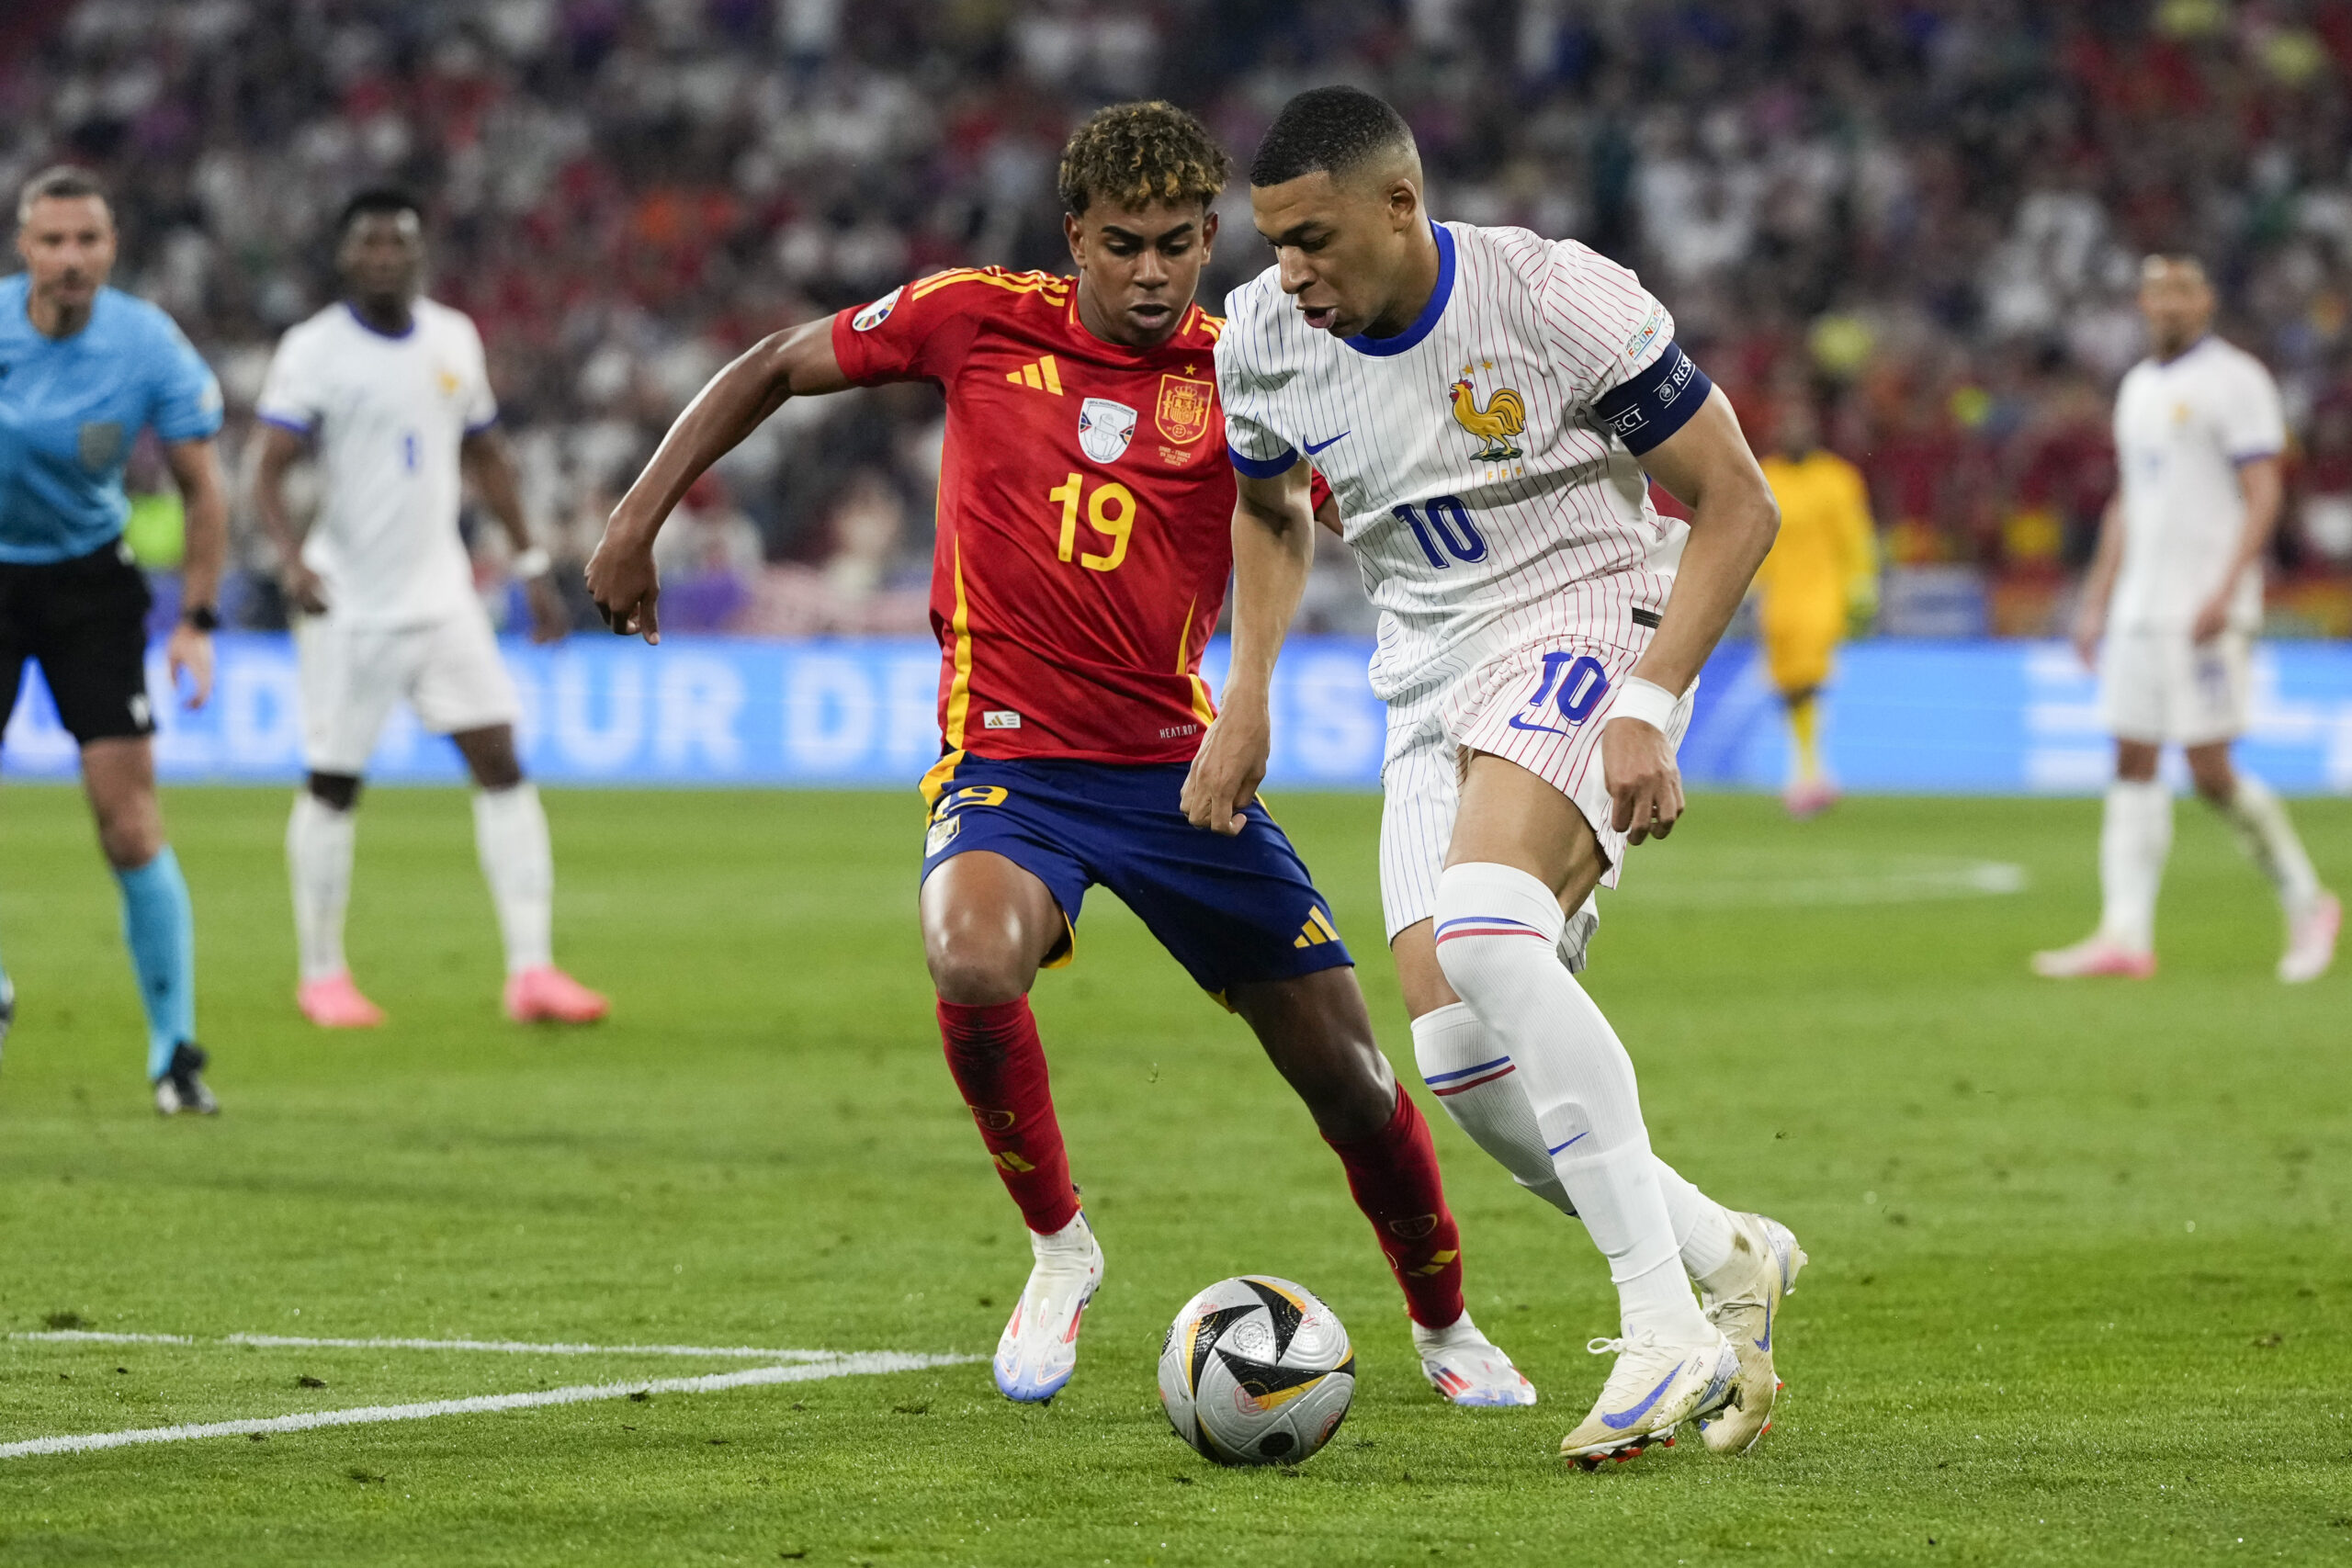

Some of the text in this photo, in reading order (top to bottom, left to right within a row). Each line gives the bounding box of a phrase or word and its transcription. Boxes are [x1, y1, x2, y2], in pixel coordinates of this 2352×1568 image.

[1049, 472, 1137, 572] 19
[1391, 494, 1488, 570] 10
[1530, 651, 1611, 727] 10
[1159, 724, 1198, 739] HEAT.RDY
